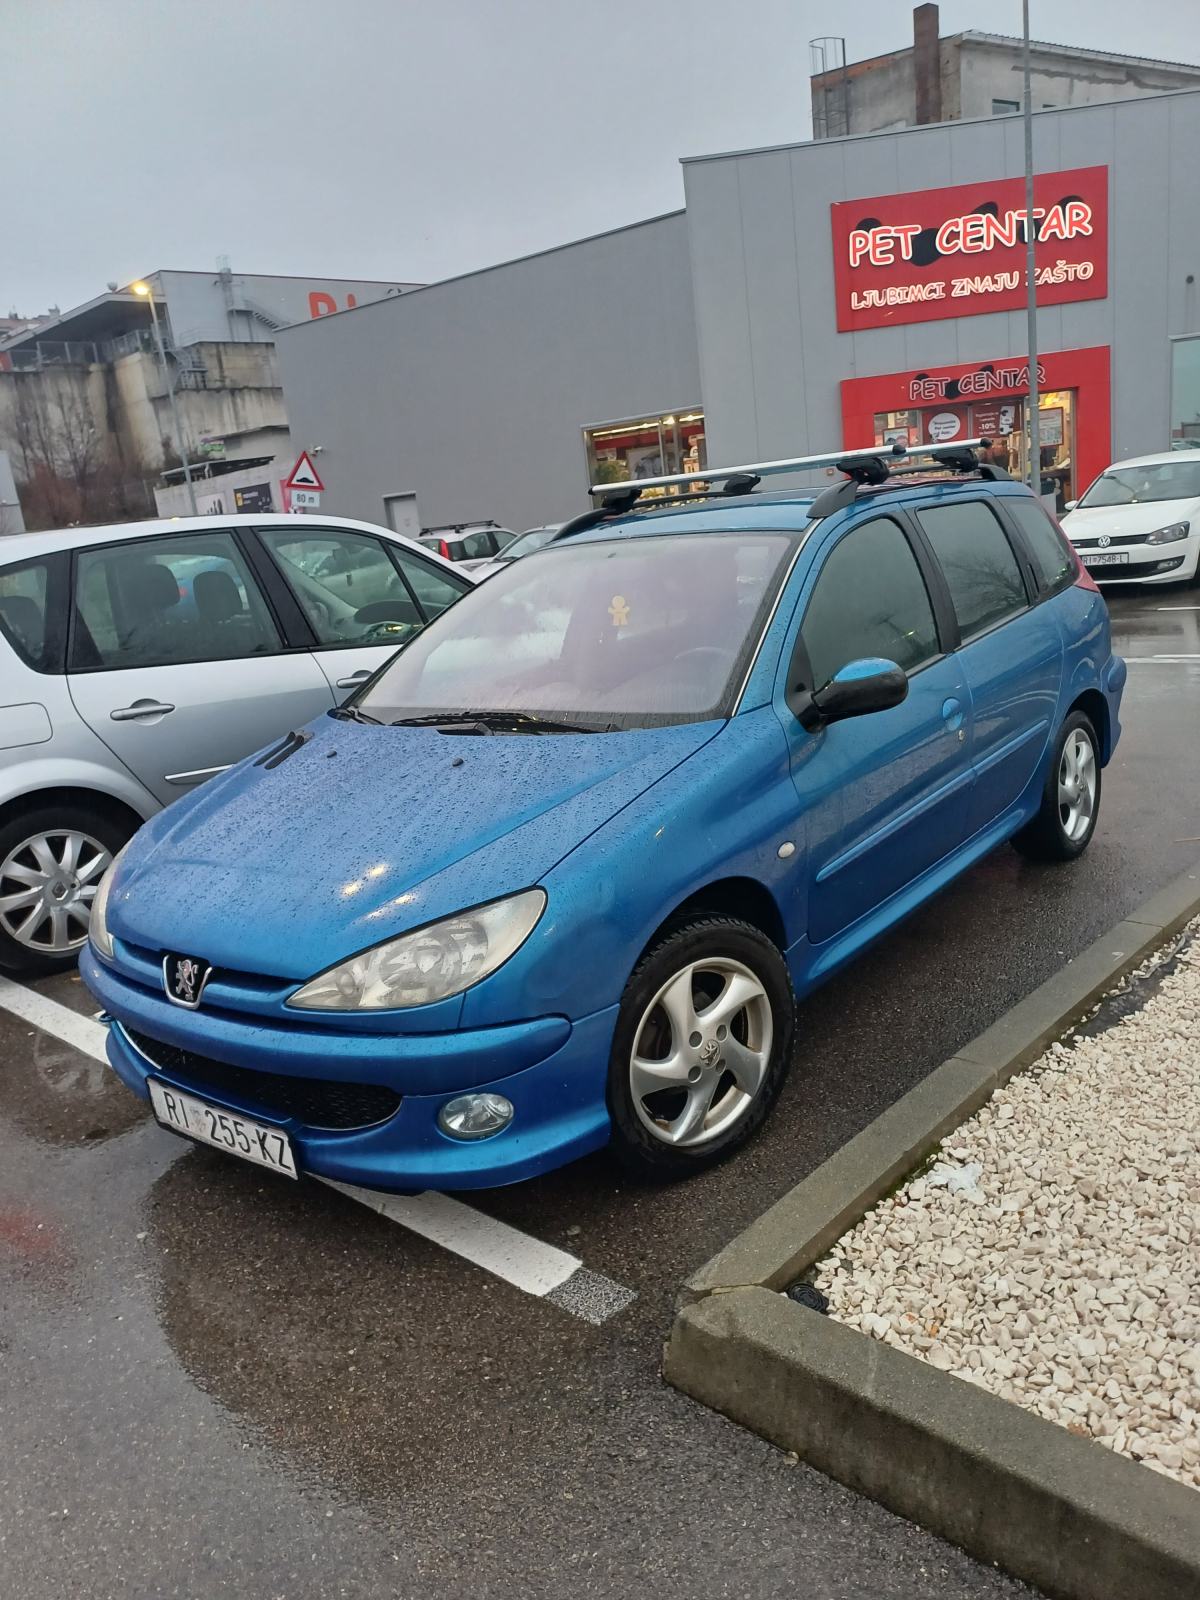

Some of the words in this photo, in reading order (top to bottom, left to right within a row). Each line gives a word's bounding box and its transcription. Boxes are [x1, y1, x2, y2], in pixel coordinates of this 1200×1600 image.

[850, 225, 921, 267] PET
[935, 201, 1093, 255] CENTAR
[851, 282, 945, 310] LJUBIMCI
[951, 271, 1019, 297] ZNAJU
[910, 377, 950, 401] PET
[297, 494, 306, 503] 80
[163, 1090, 189, 1128] RI
[205, 1109, 292, 1170] 255-KZ
